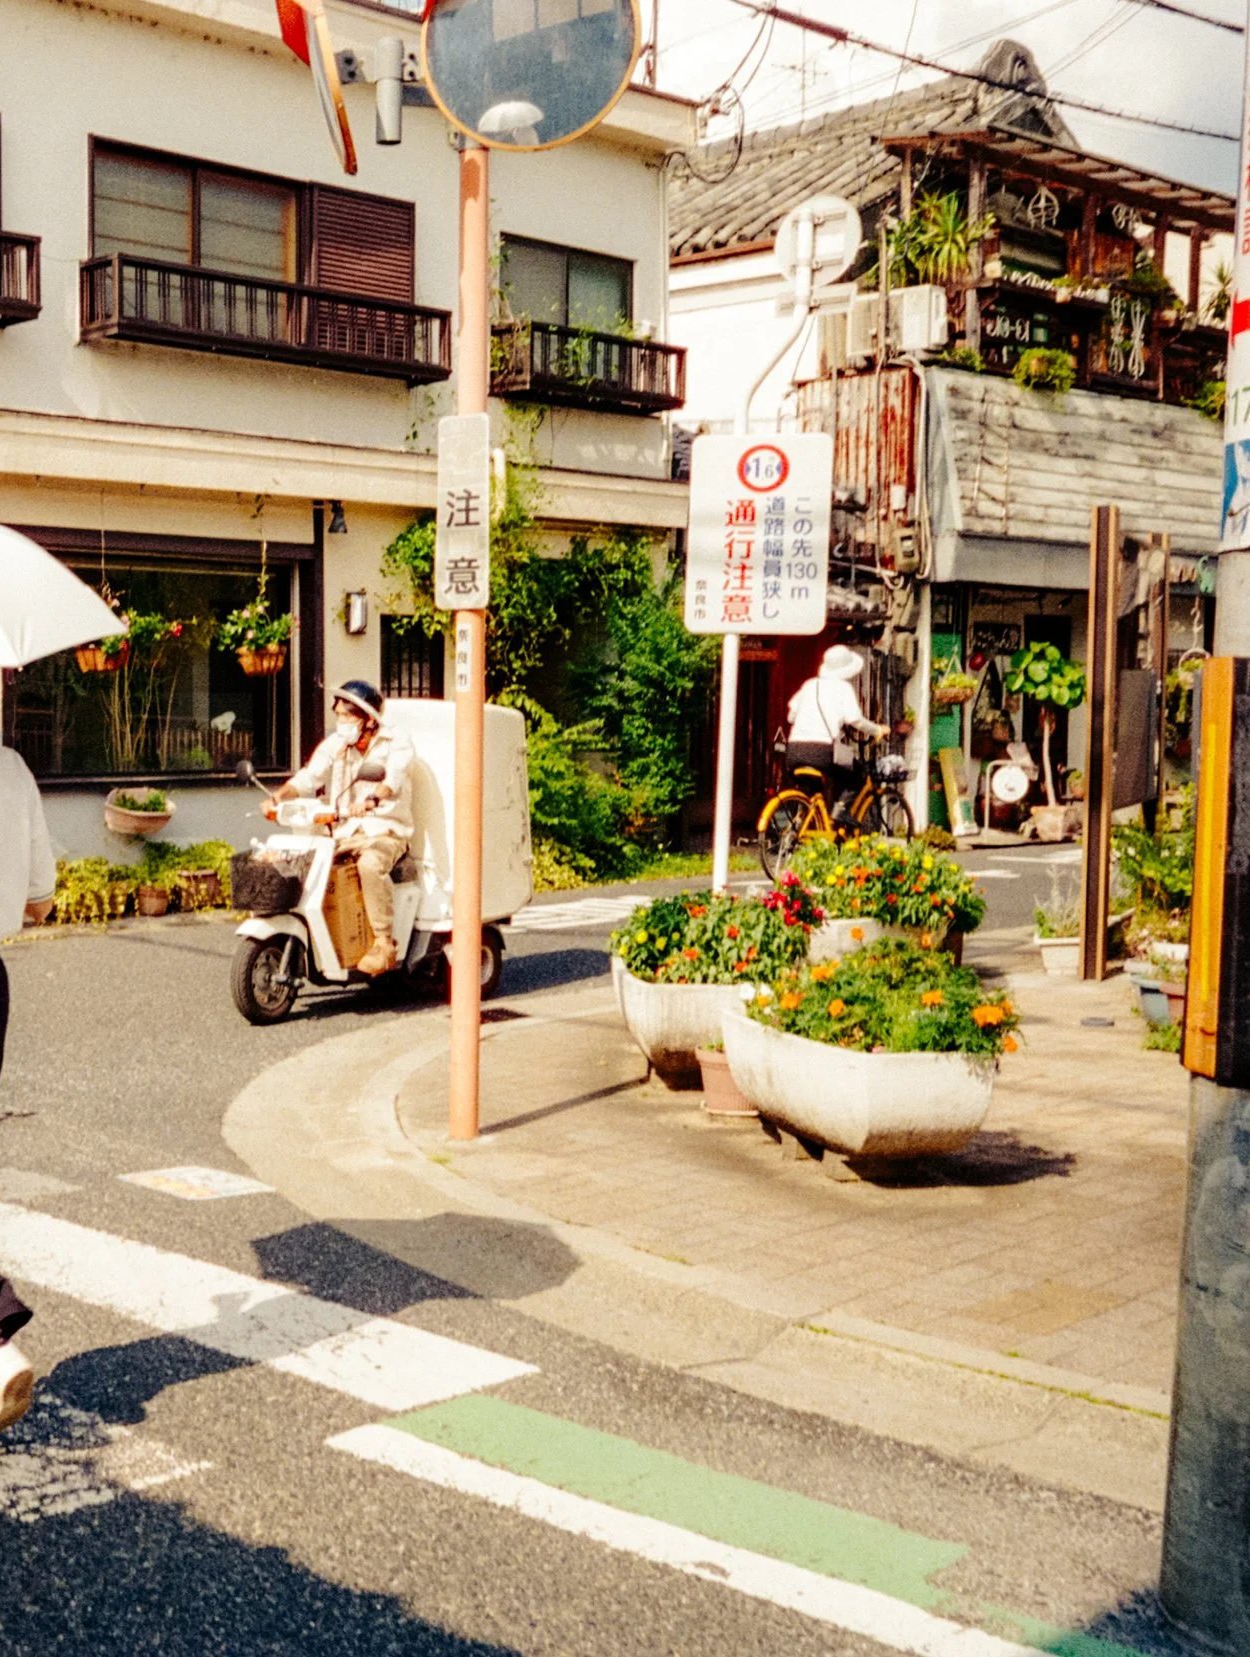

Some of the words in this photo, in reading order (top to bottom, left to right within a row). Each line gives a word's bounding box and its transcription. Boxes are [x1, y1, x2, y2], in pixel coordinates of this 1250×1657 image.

[444, 489, 481, 595] 注意
[721, 499, 757, 624] 通行注意
[762, 496, 786, 619] 道路幅員狭し
[786, 497, 818, 600] この先130m
